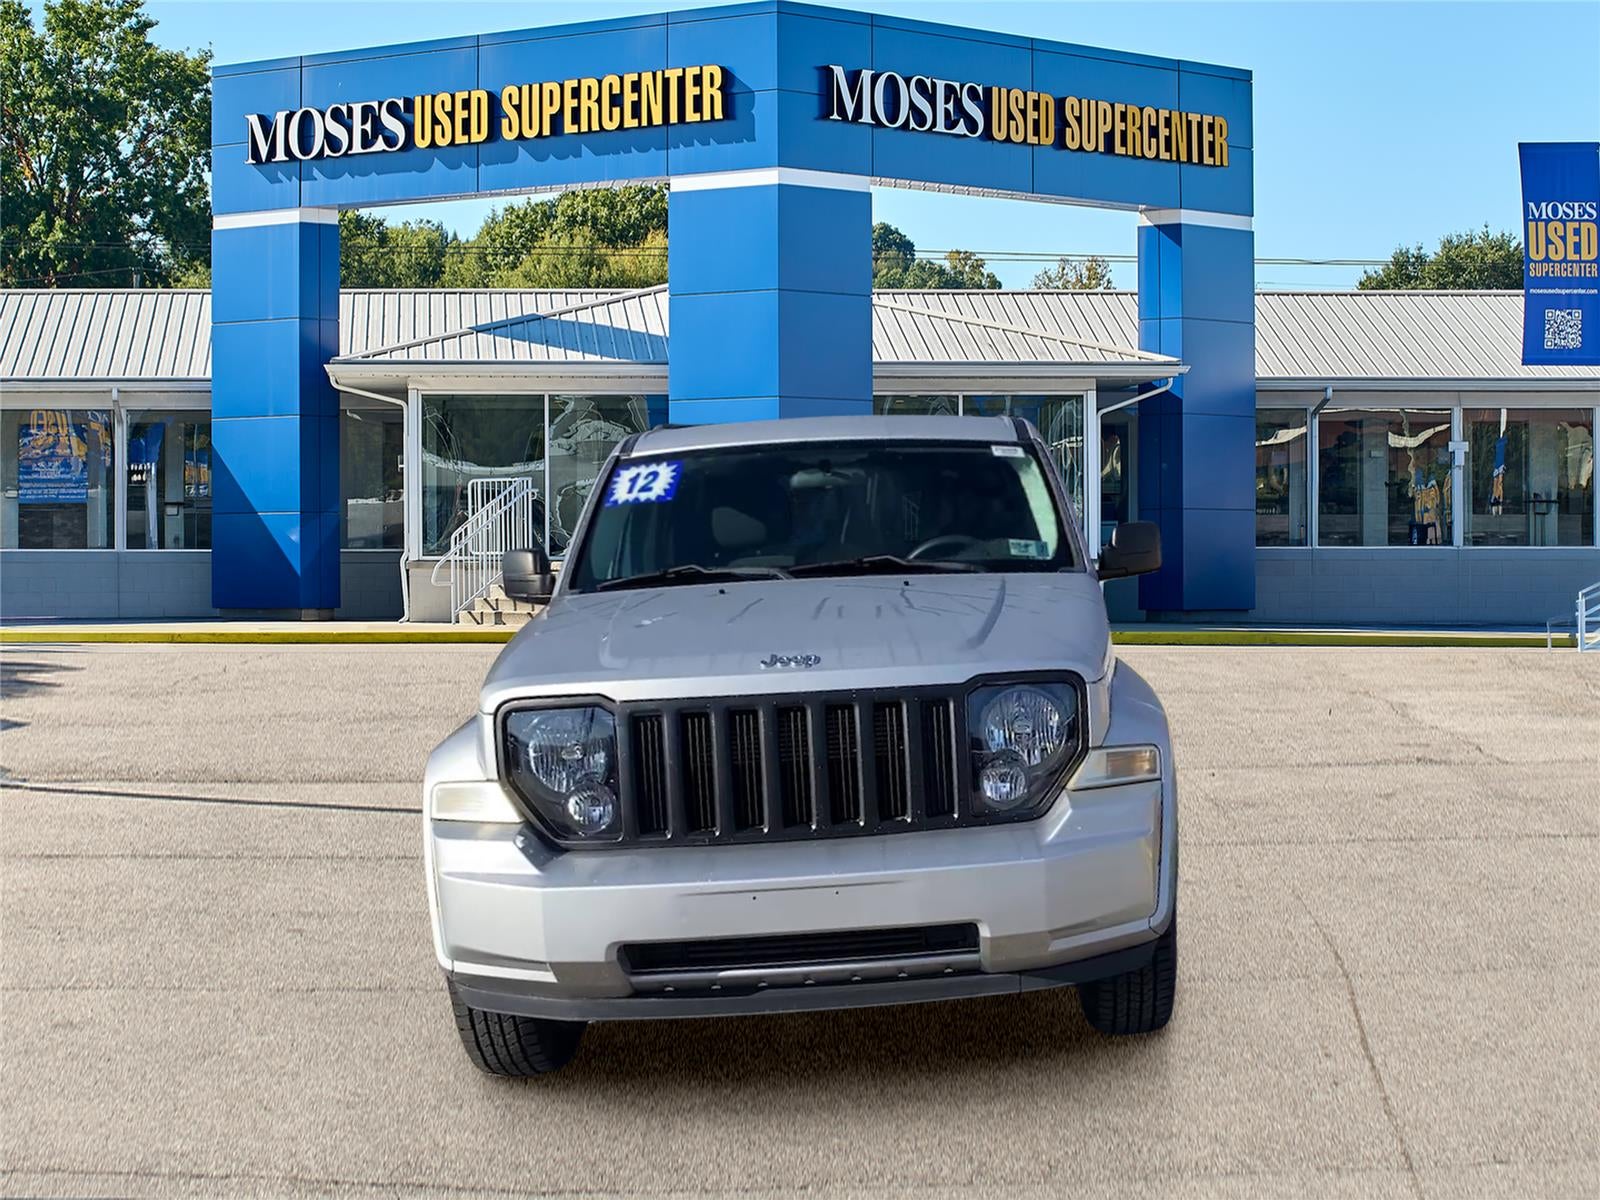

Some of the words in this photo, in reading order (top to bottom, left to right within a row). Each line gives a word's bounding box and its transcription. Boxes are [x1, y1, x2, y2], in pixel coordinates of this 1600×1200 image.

[244, 98, 406, 164] MOSES
[413, 89, 489, 149] USED
[500, 63, 724, 141] SUPERCENTER
[829, 64, 985, 138] MOSES
[991, 86, 1055, 146] USED
[1065, 96, 1229, 167] SUPERCENTER
[1527, 201, 1597, 220] MOSES
[1528, 221, 1598, 261] USED
[1529, 262, 1598, 278] SUPERCENTER
[626, 470, 660, 495] 12
[760, 654, 821, 669] Jeep
